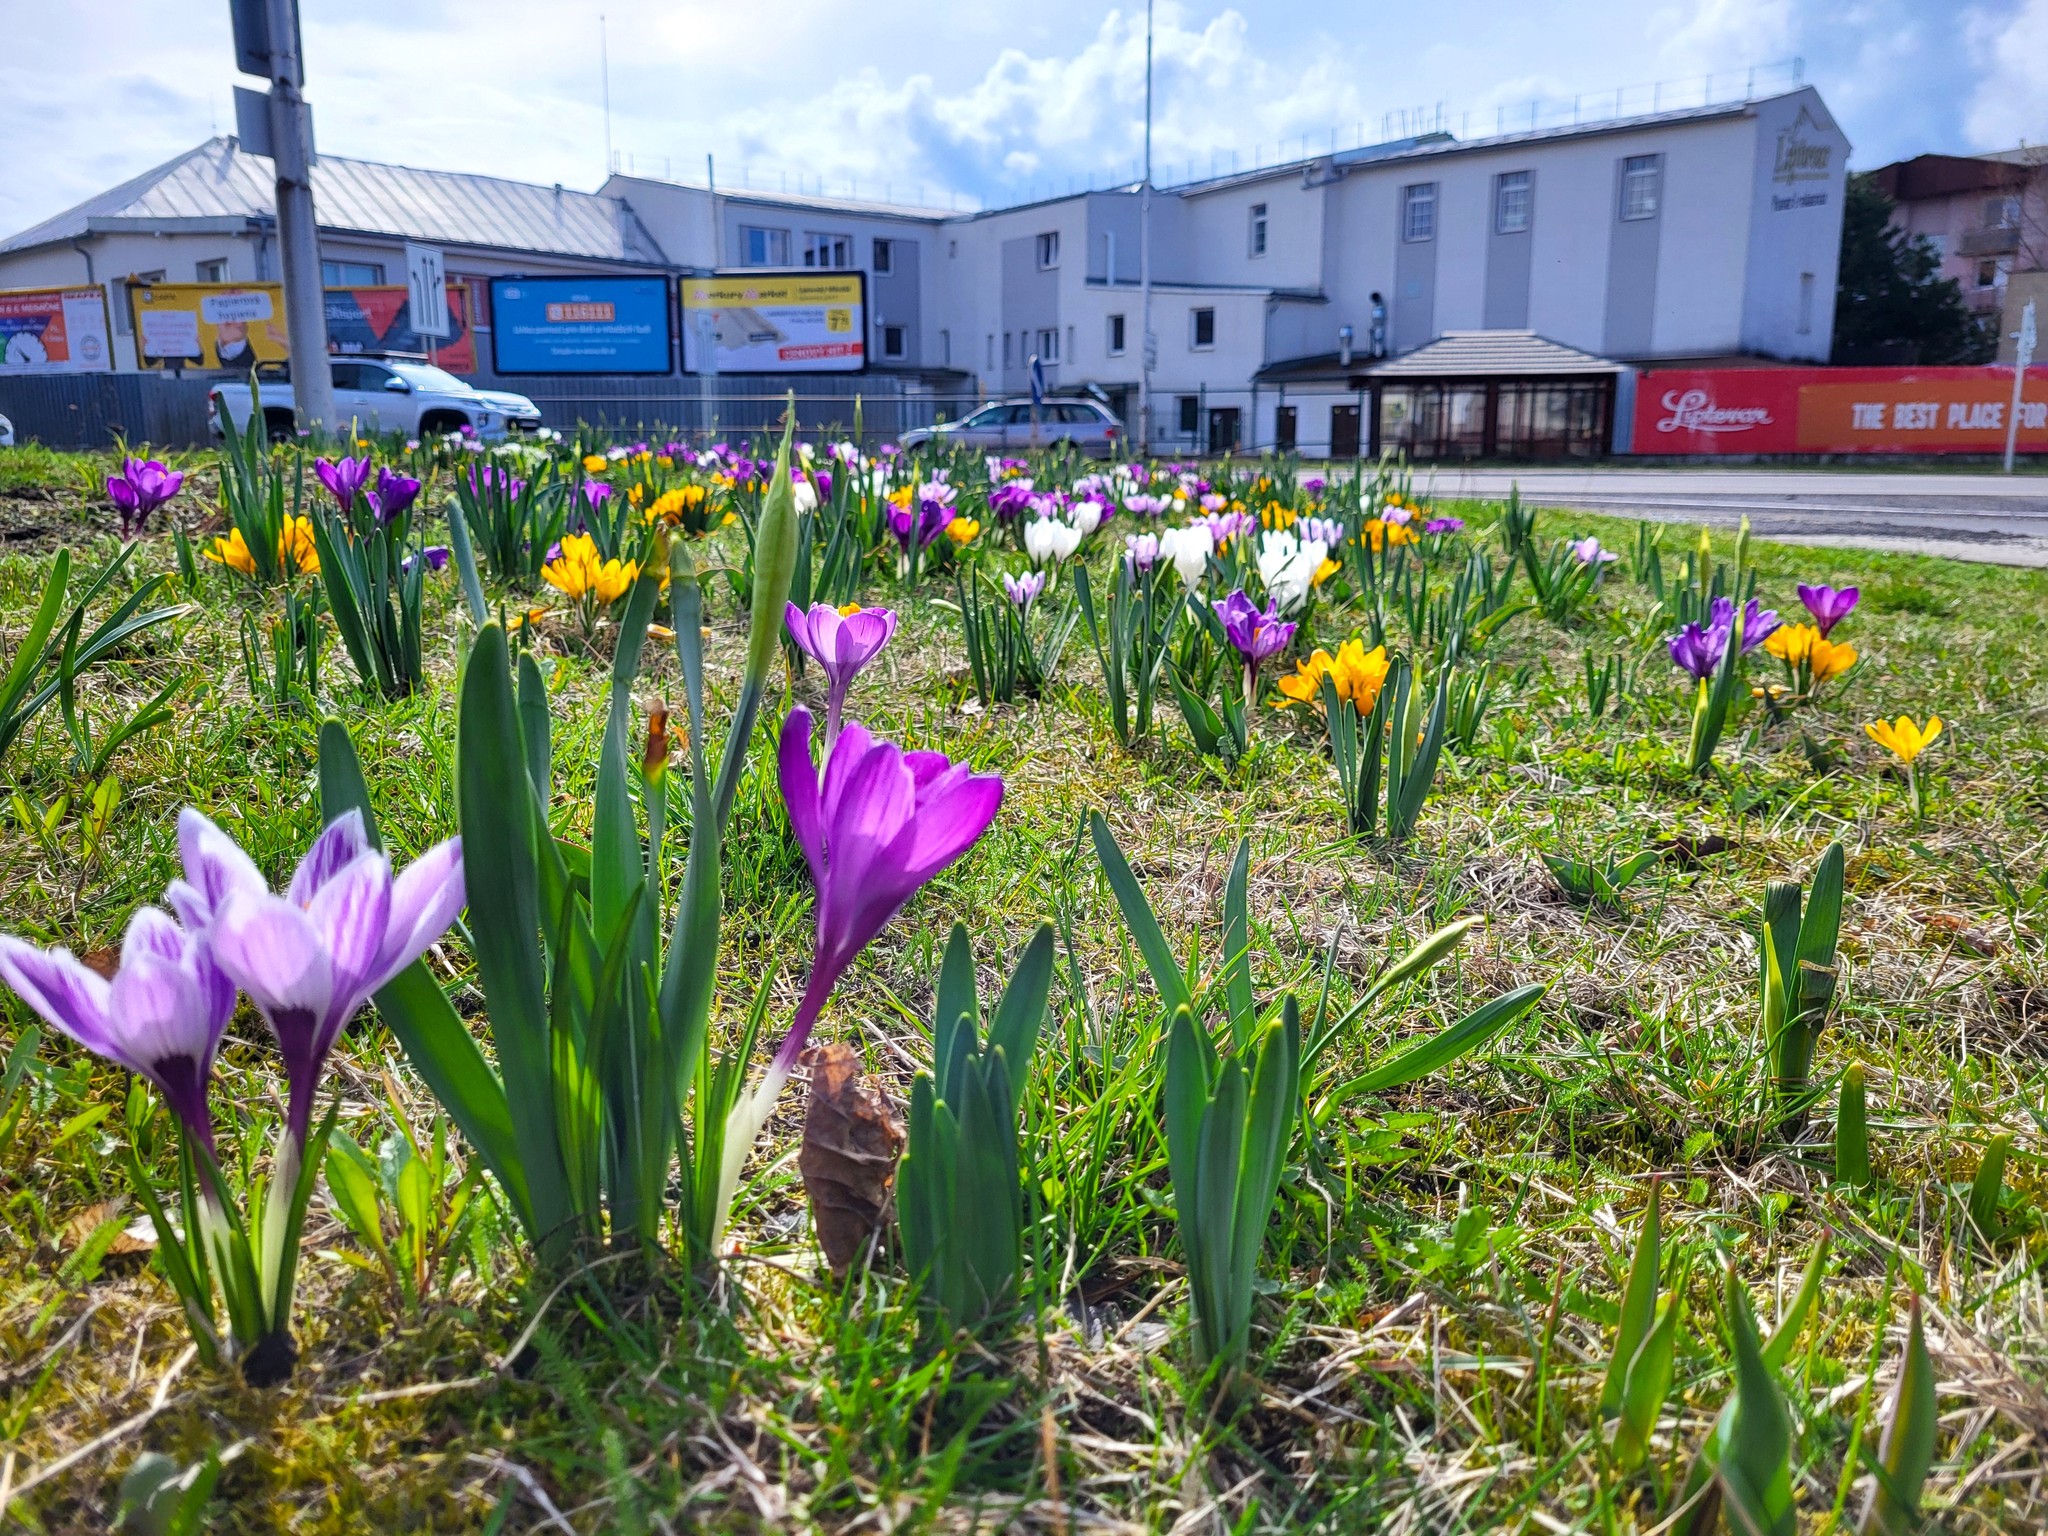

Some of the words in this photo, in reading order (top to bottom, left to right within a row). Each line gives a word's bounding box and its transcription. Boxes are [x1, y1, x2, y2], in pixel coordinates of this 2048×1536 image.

[1852, 403, 1886, 429] THE
[1893, 403, 1939, 429] BEST
[1946, 403, 2005, 429] PLACE
